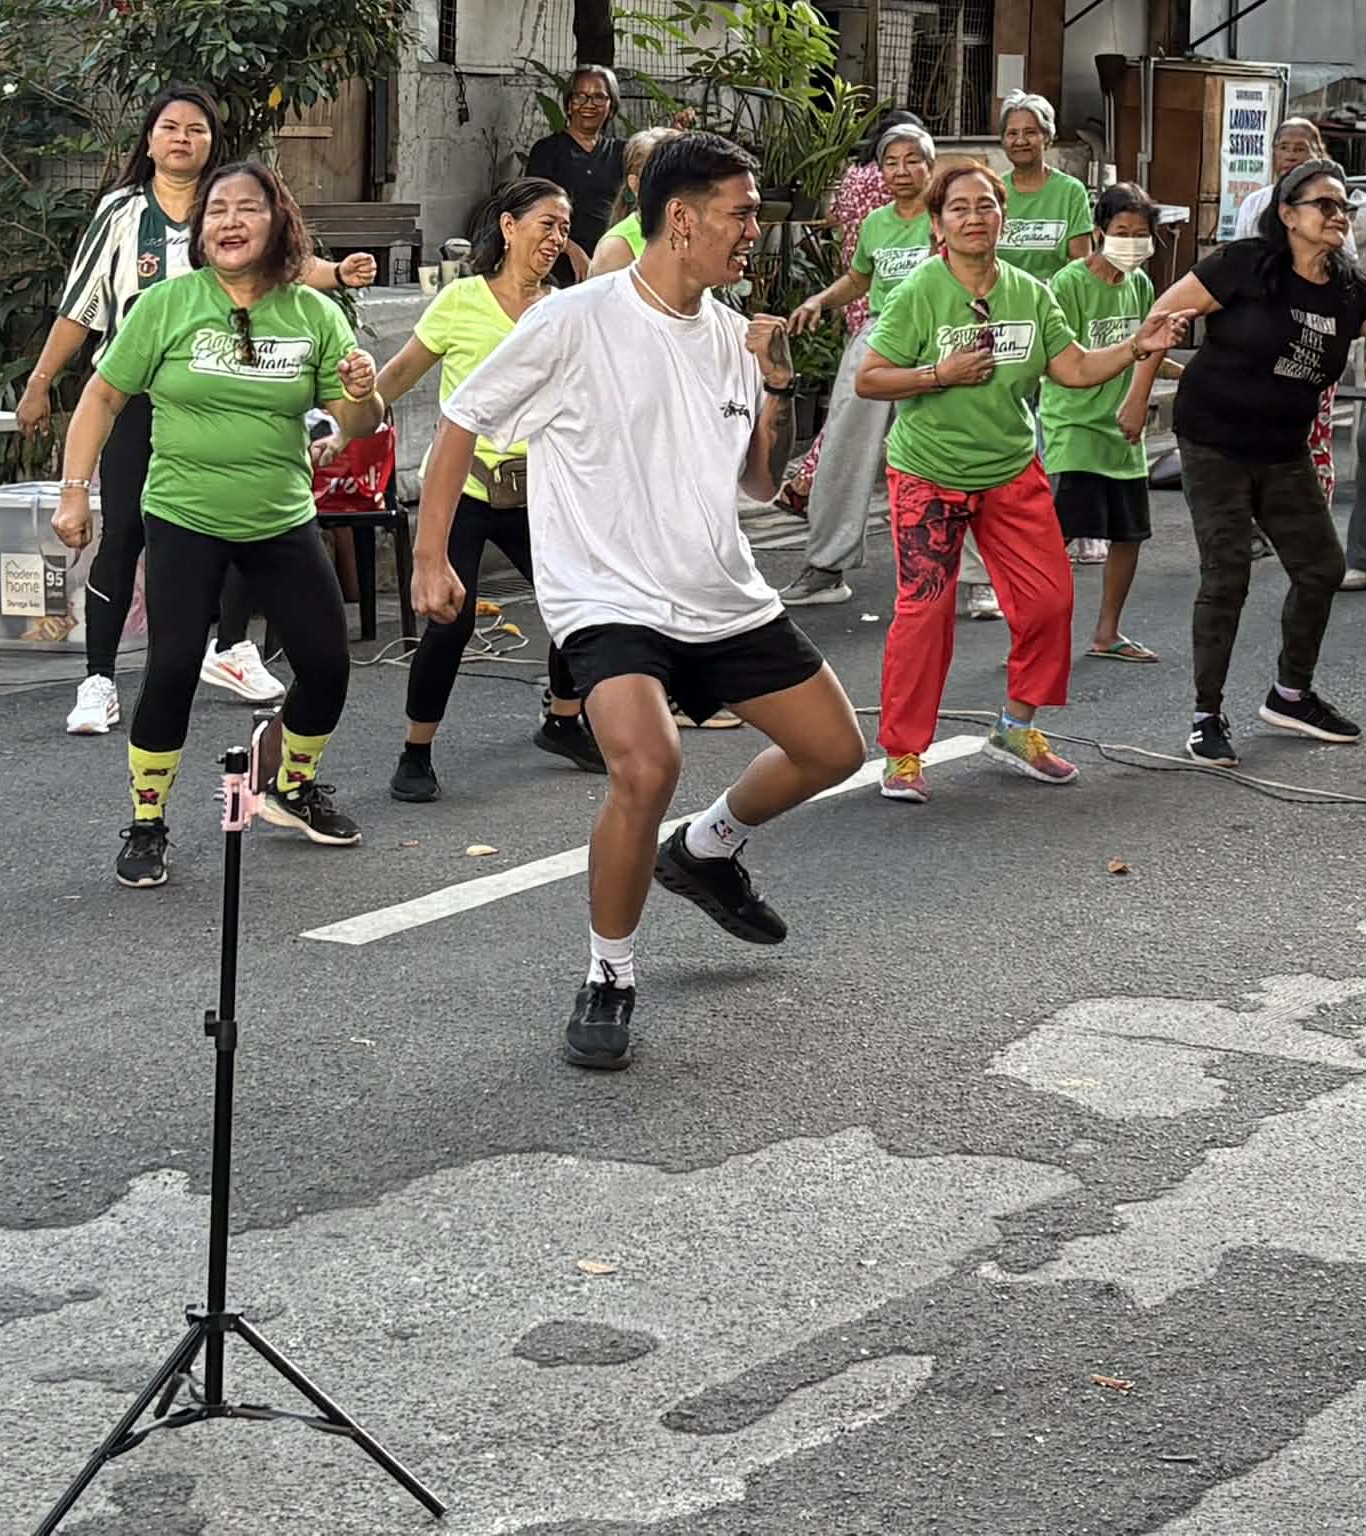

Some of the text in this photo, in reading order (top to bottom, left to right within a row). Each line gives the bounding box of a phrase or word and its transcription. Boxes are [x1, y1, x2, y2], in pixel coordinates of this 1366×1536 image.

[1229, 109, 1267, 131] LAUNDRY
[1229, 134, 1264, 156] SERVICE
[6, 580, 40, 593] home
[46, 571, 64, 586] 95
